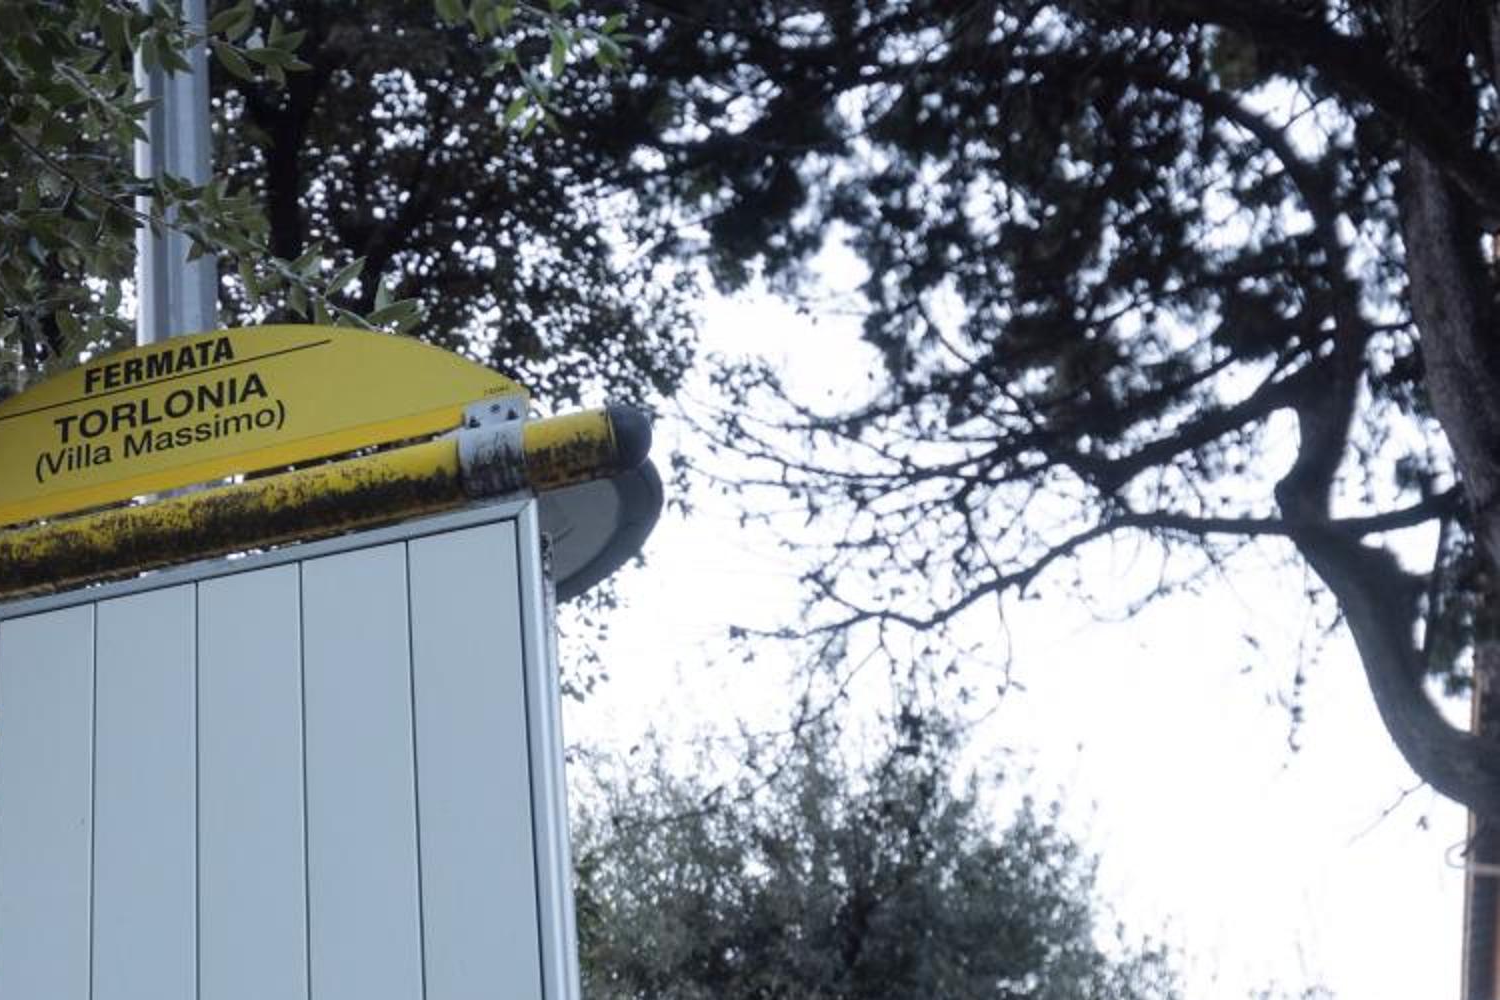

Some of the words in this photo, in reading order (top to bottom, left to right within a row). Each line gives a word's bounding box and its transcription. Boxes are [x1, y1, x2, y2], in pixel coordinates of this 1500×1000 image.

[84, 336, 234, 394] FERMATA
[35, 444, 111, 483] (Villa
[124, 399, 285, 458] Massimo)
[54, 372, 268, 443] TORLONIA
